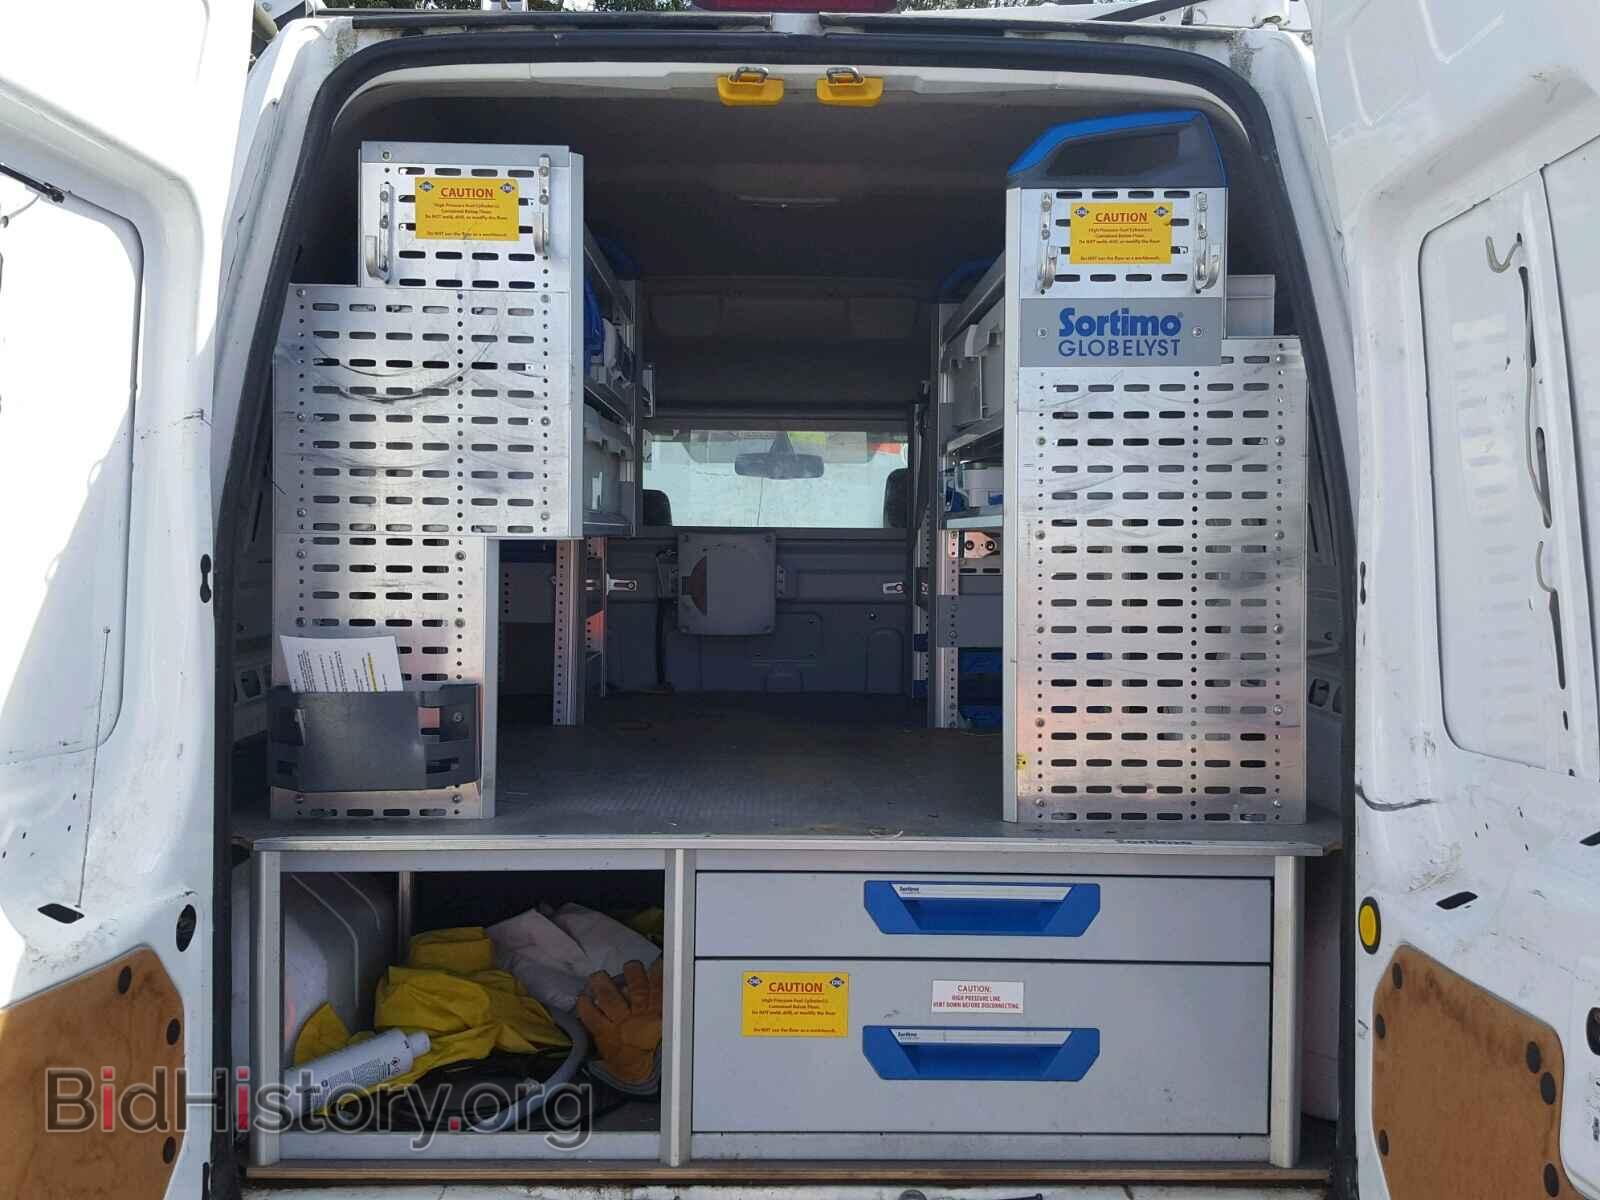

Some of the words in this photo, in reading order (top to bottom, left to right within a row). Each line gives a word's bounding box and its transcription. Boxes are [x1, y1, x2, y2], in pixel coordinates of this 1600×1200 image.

[440, 187, 494, 198] CAUTION
[1095, 212, 1148, 222] CAUTION
[1059, 307, 1182, 337] Sortimo
[1058, 339, 1180, 357] GLOBELYST
[768, 982, 823, 993] CAUTION
